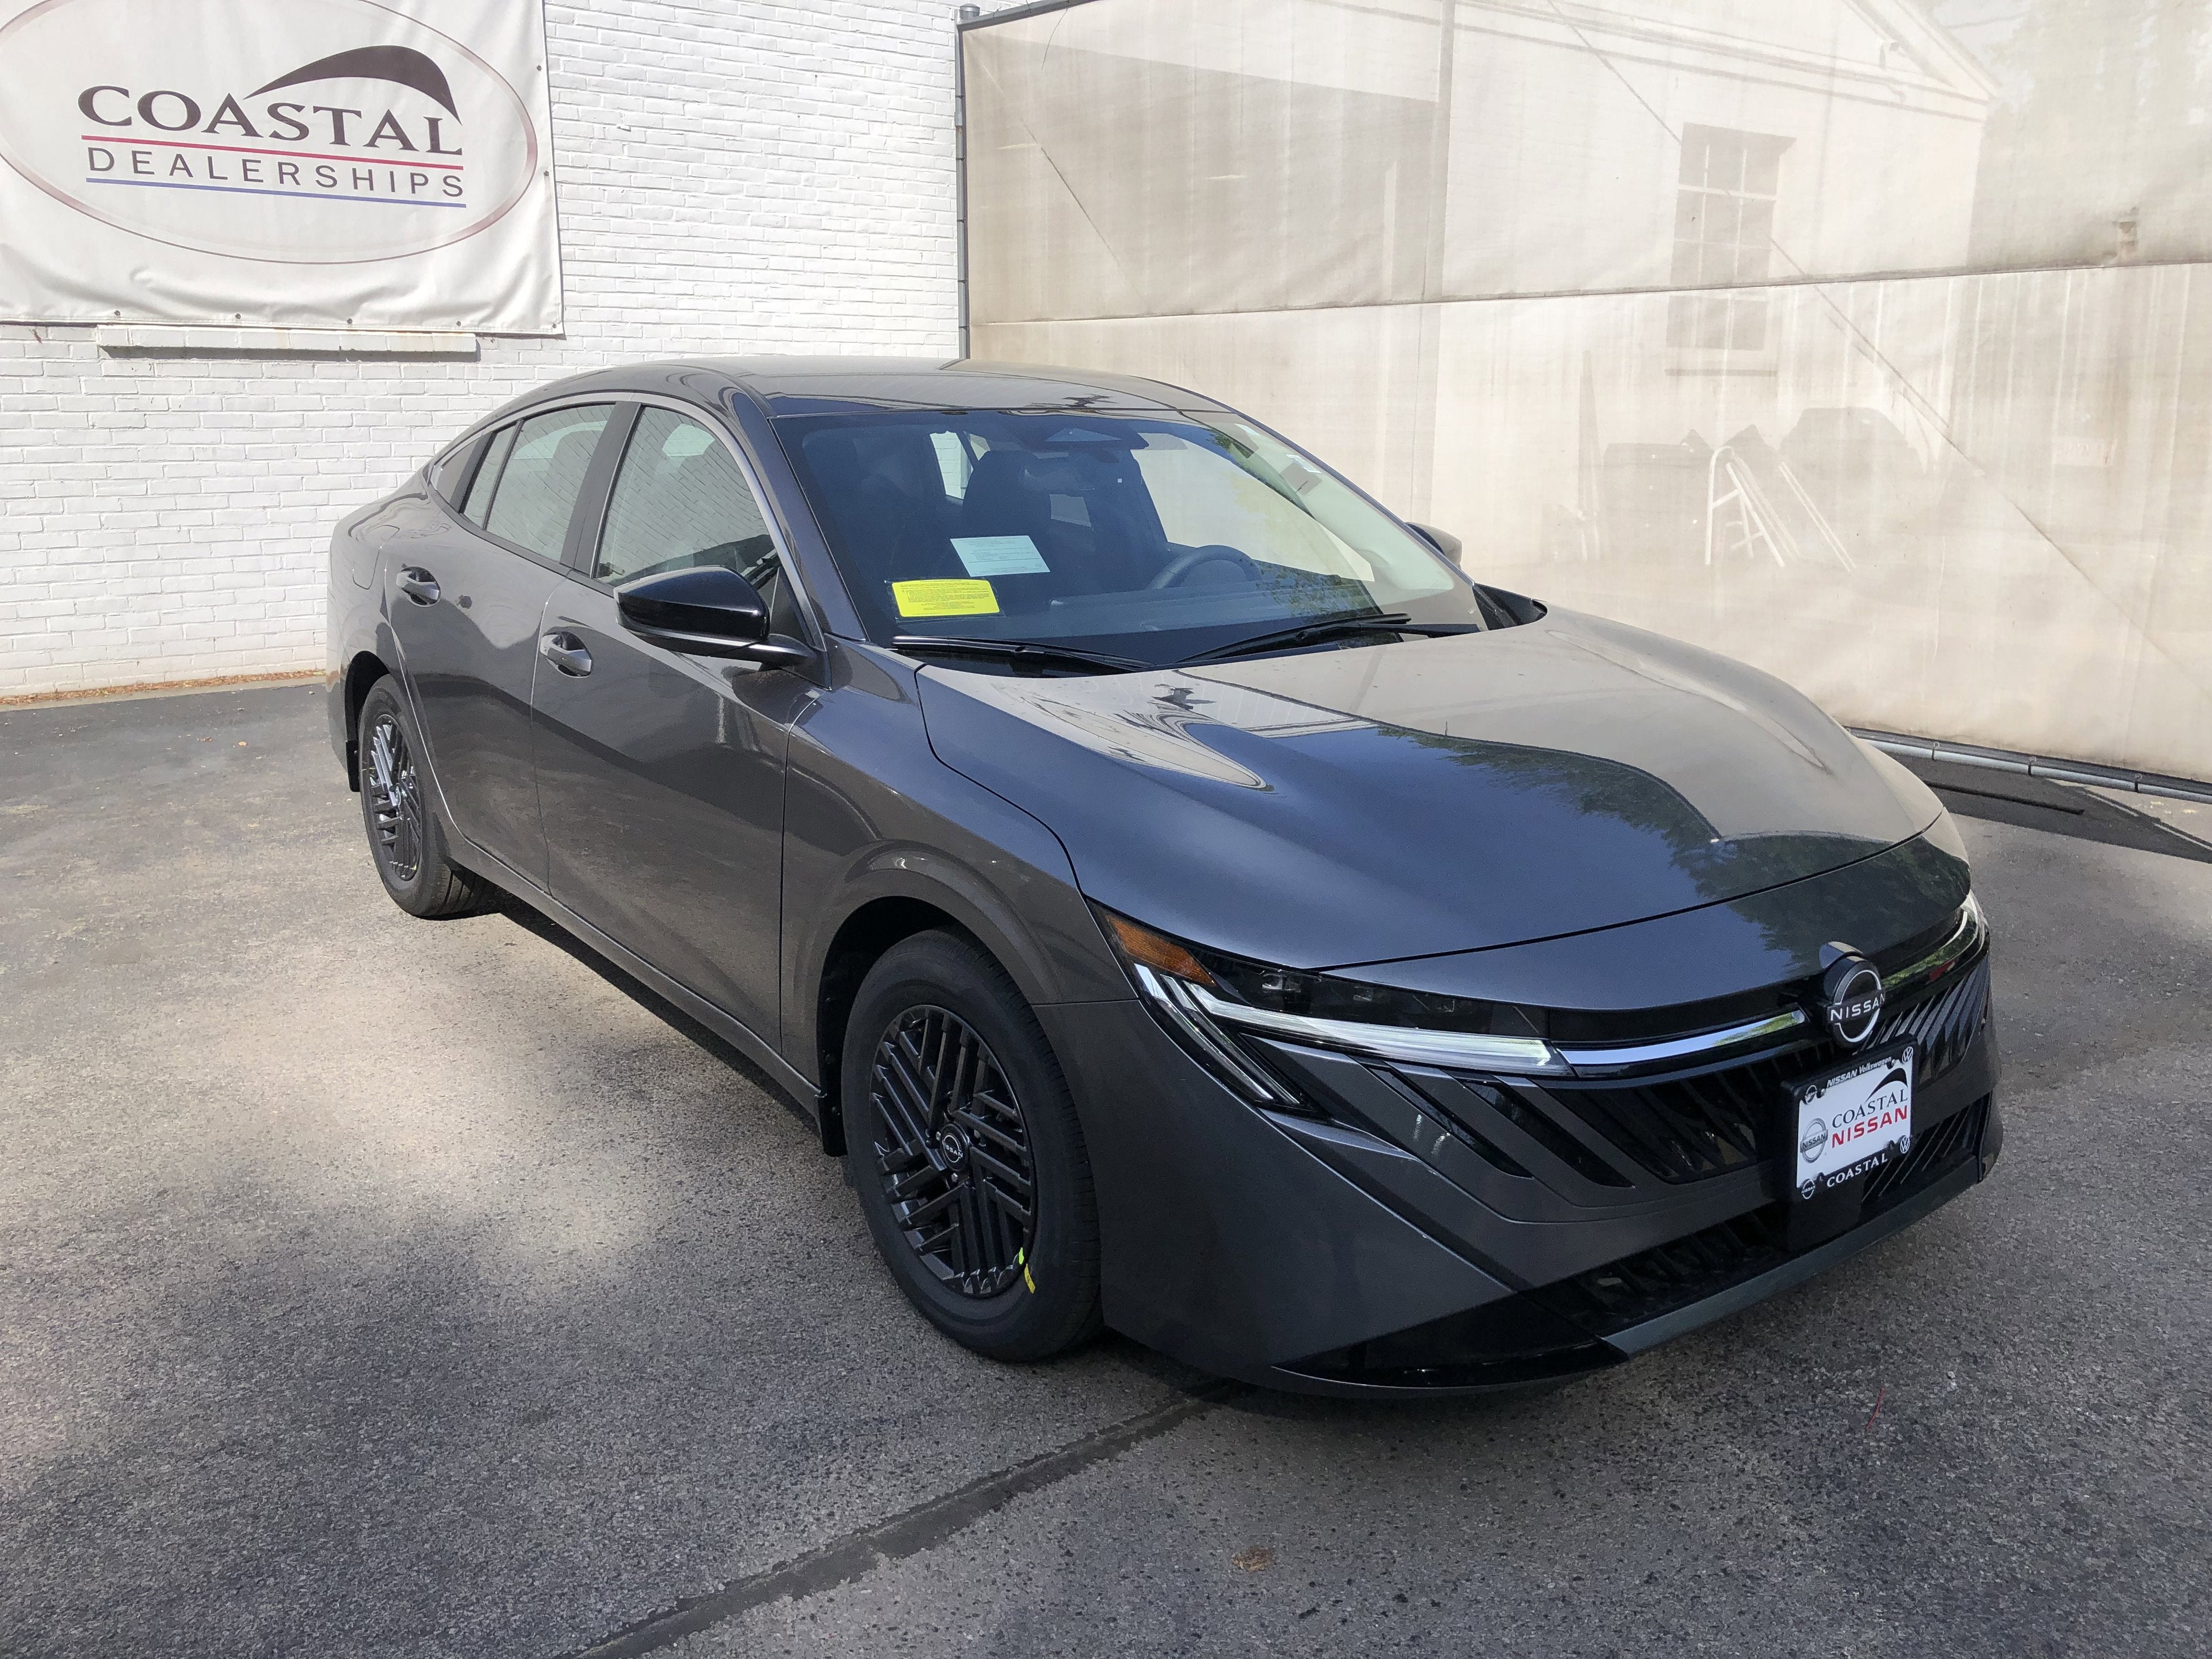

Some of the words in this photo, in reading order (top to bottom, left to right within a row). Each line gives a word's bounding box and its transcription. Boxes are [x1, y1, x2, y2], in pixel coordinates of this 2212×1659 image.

[78, 85, 463, 156] COASTAL
[88, 147, 464, 198] DEALERSHIPS
[1830, 993, 1885, 1021] NISSAN
[1826, 1069, 1858, 1088] NISSAN
[1859, 1056, 1892, 1074] Volkswagen
[1832, 1088, 1908, 1128] COASTAL
[1832, 1105, 1908, 1148] NISSAN
[1802, 1132, 1826, 1149] NISSAN
[1826, 1153, 1888, 1188] COASTAL
